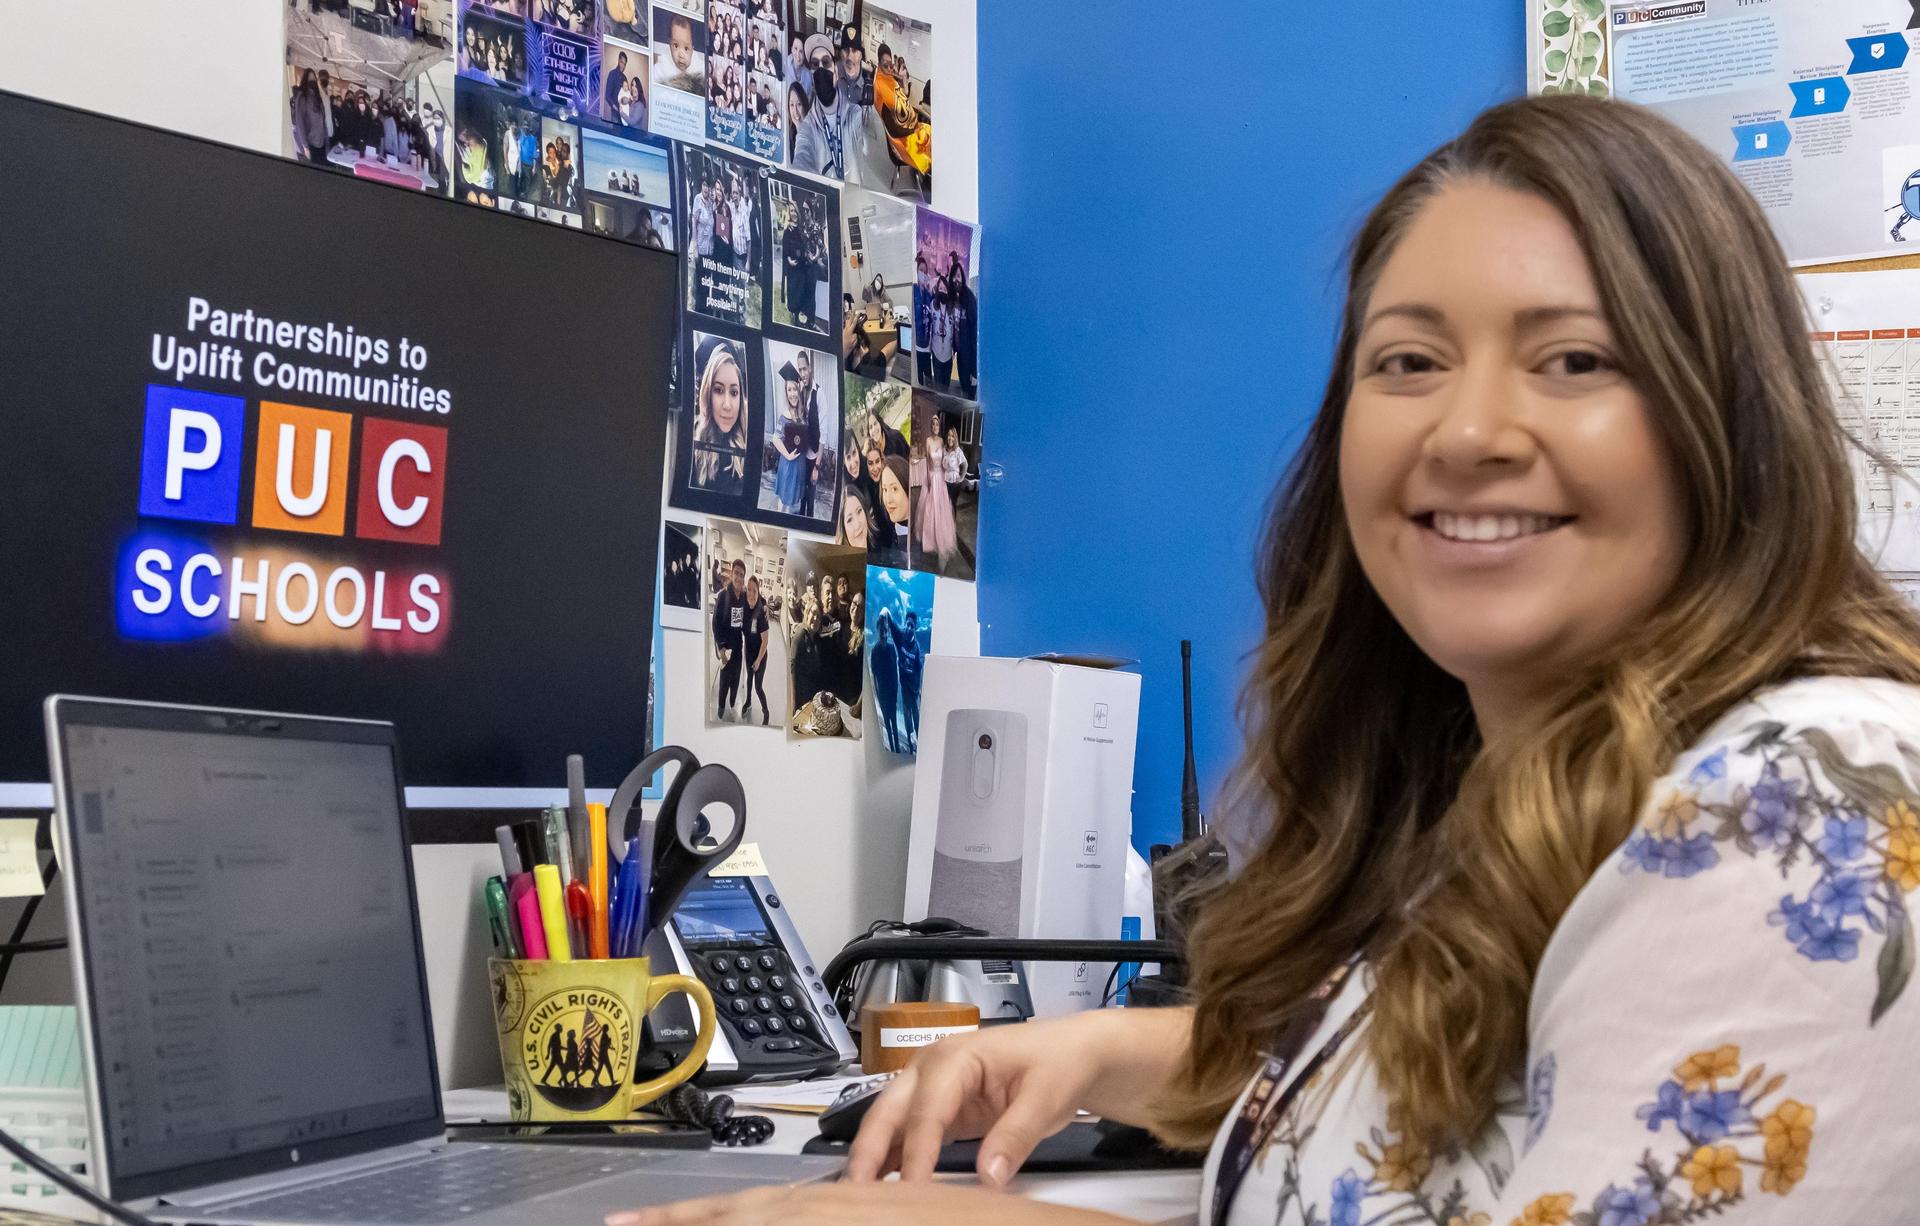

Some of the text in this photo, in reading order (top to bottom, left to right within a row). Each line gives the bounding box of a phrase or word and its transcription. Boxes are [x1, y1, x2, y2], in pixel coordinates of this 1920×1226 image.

[1651, 3, 1705, 18] Community
[544, 56, 585, 77] ETHEREAL
[553, 71, 579, 87] NIGHT
[702, 257, 750, 283] With them by my
[745, 286, 750, 298] is
[187, 296, 428, 371] Partnerships to
[151, 333, 451, 415] Uplift Communities
[131, 547, 441, 634] SCHOOLS
[526, 993, 630, 1071] U.S. CIVIL RIGHTS TRAIL
[896, 1033, 932, 1043] CCECHS
